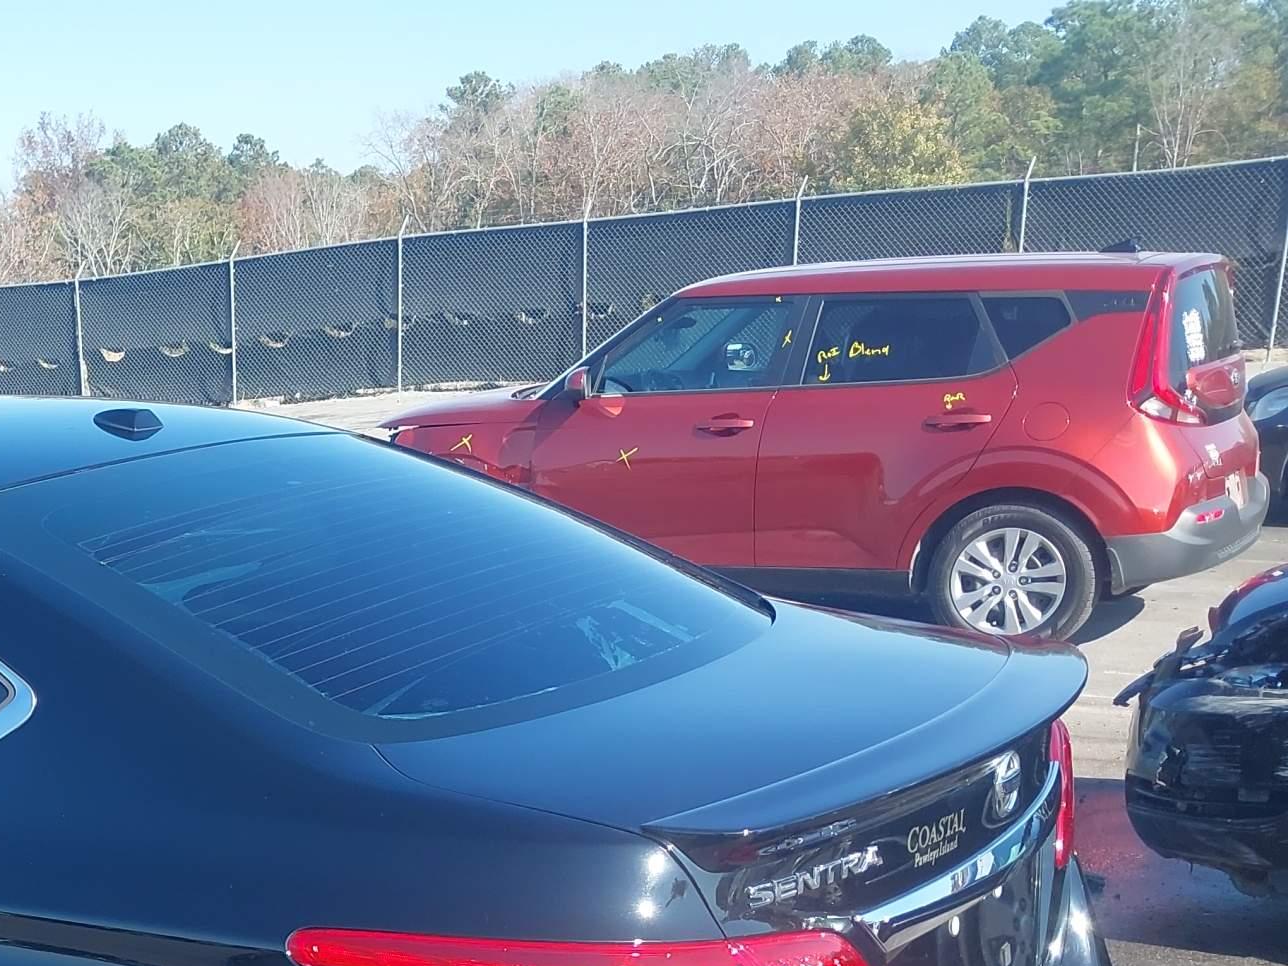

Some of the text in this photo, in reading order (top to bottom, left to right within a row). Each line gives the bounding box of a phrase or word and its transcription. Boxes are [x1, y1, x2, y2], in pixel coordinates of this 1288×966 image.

[848, 341, 890, 358] Blend
[907, 808, 967, 854] COASTAL
[939, 834, 959, 857] Island
[744, 845, 884, 908] SENTRA
